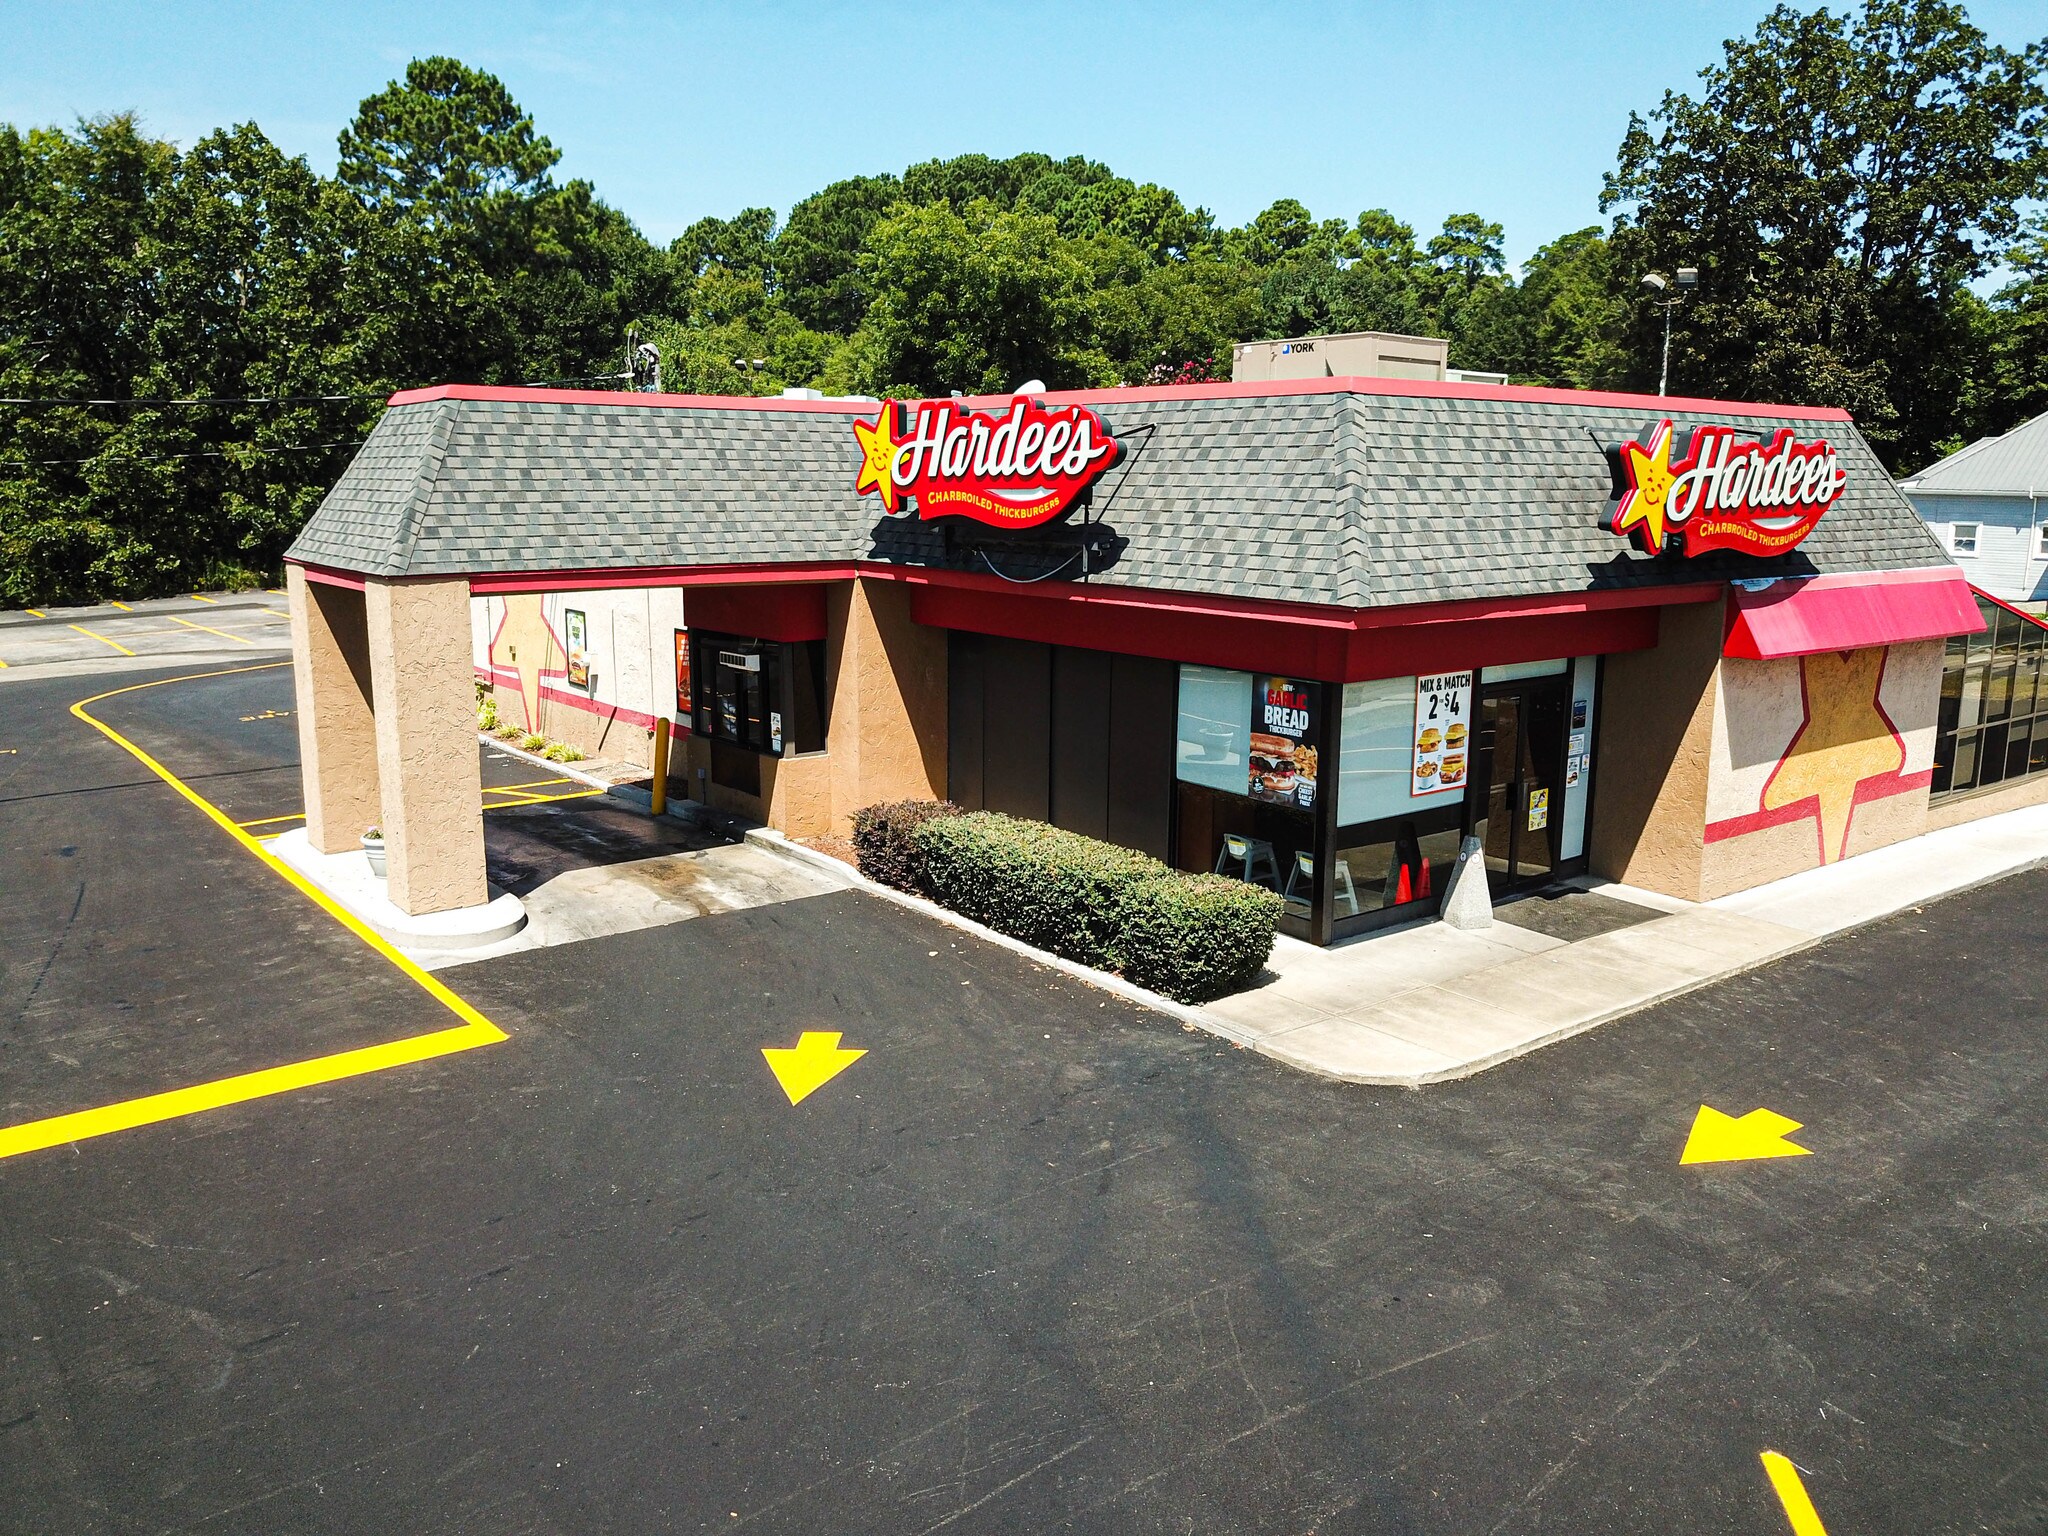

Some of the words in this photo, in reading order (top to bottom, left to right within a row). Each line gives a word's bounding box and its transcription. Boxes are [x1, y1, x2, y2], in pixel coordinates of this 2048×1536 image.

[1291, 342, 1315, 354] YORK
[891, 404, 1109, 486] Hardee's
[1666, 435, 1847, 522] Hardee's
[928, 490, 993, 510] CHARBROILED
[993, 497, 1061, 519] THICKBURGERS
[1699, 522, 1758, 541] CHARBROILED
[1759, 522, 1810, 547] THICKBURGERS
[1420, 679, 1434, 693] MIX
[1436, 677, 1442, 691] &
[1444, 674, 1471, 690] MATCH
[1267, 688, 1307, 710] GARLIC
[1429, 694, 1438, 719] 2
[1264, 704, 1309, 730] BREAD
